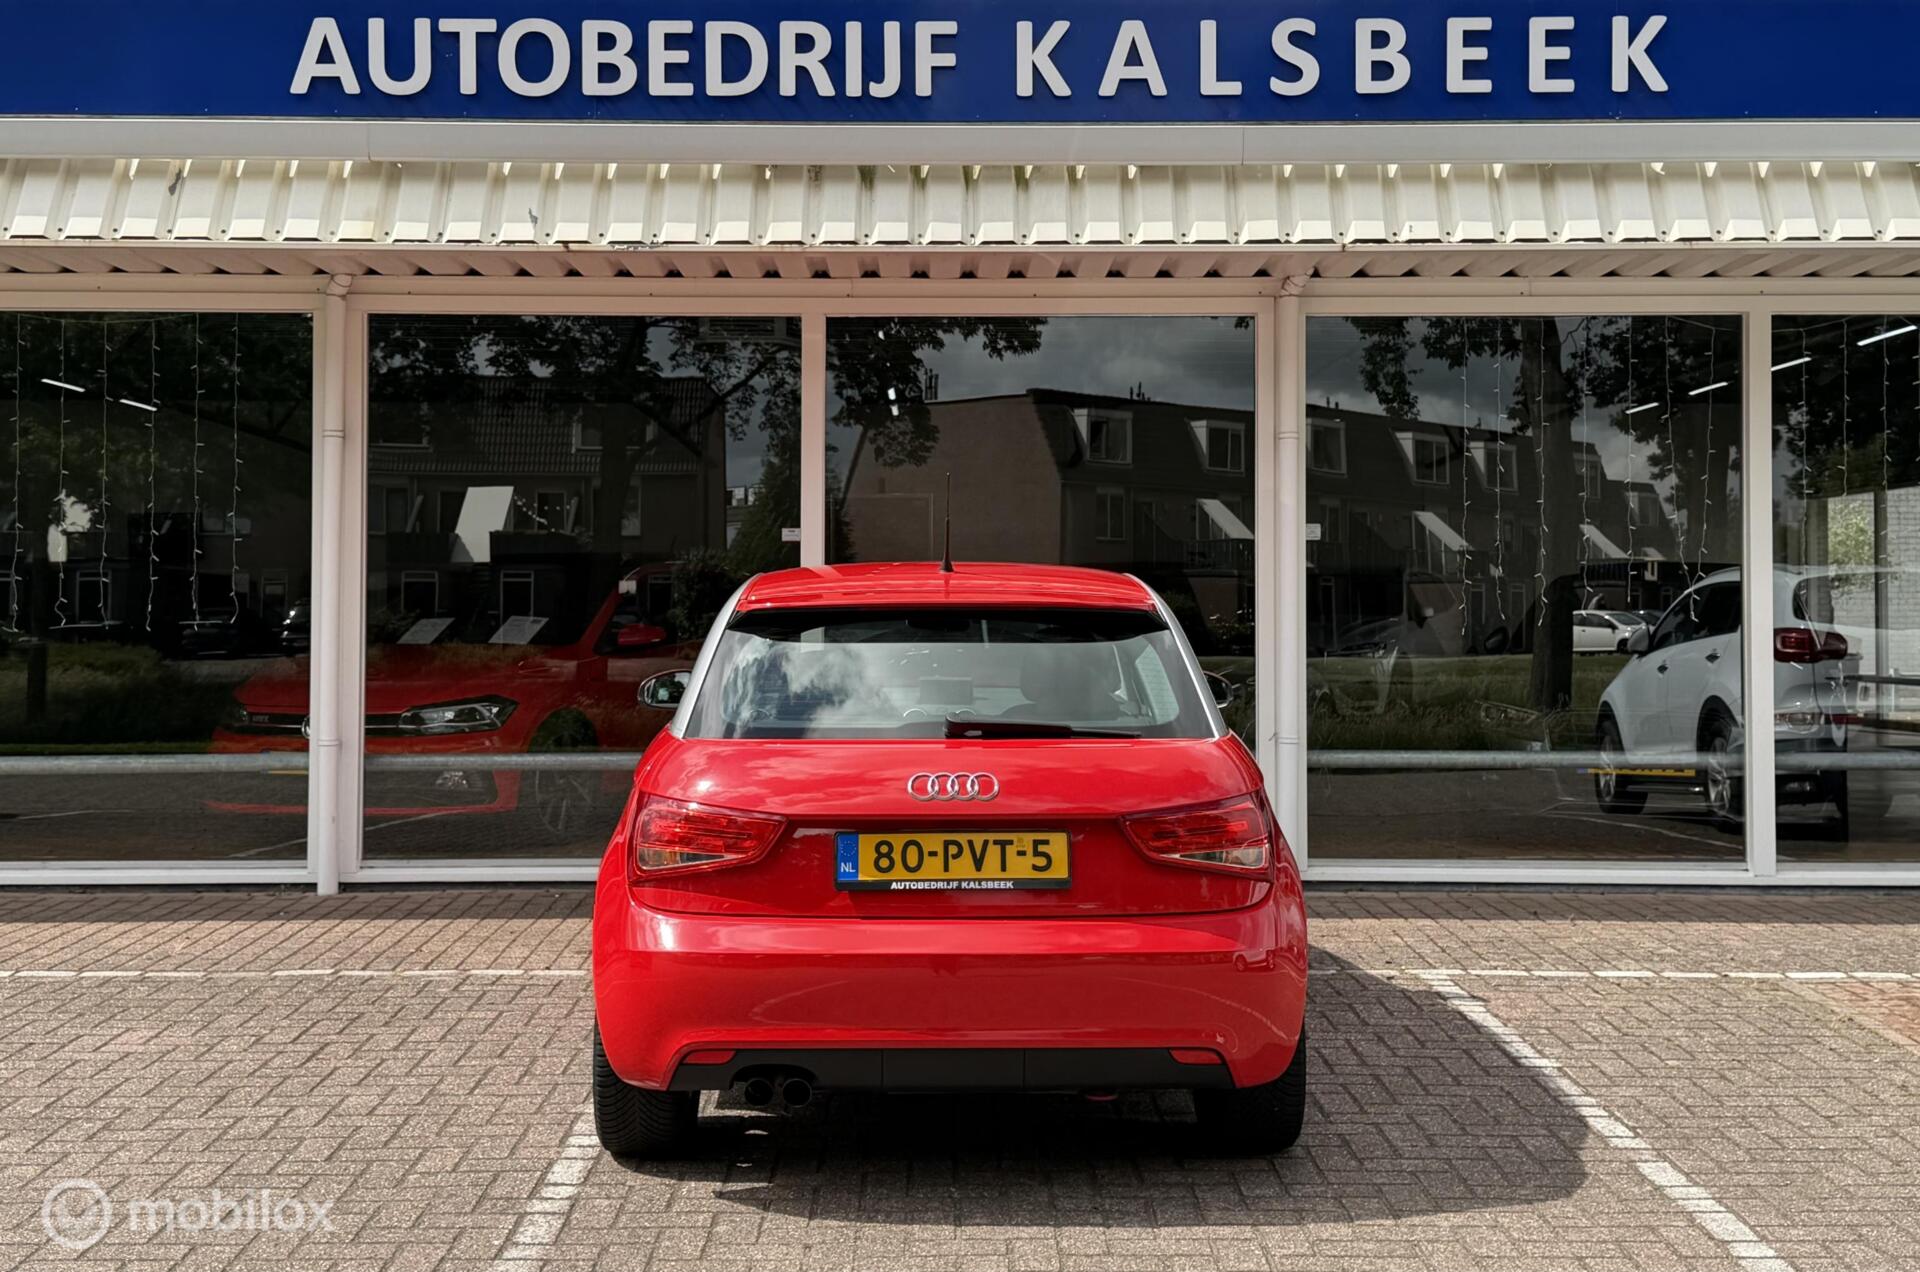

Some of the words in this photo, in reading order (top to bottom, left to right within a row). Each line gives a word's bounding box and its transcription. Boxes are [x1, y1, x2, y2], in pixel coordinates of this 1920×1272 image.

[289, 17, 959, 98] AUTOBEDRIJF
[1015, 15, 1669, 97] KALSBEEK
[873, 839, 1053, 873] 80-PVT-5
[840, 862, 856, 873] NL
[890, 881, 959, 890] AUTOBEDRIJF
[961, 881, 1014, 890] KALSBEEK
